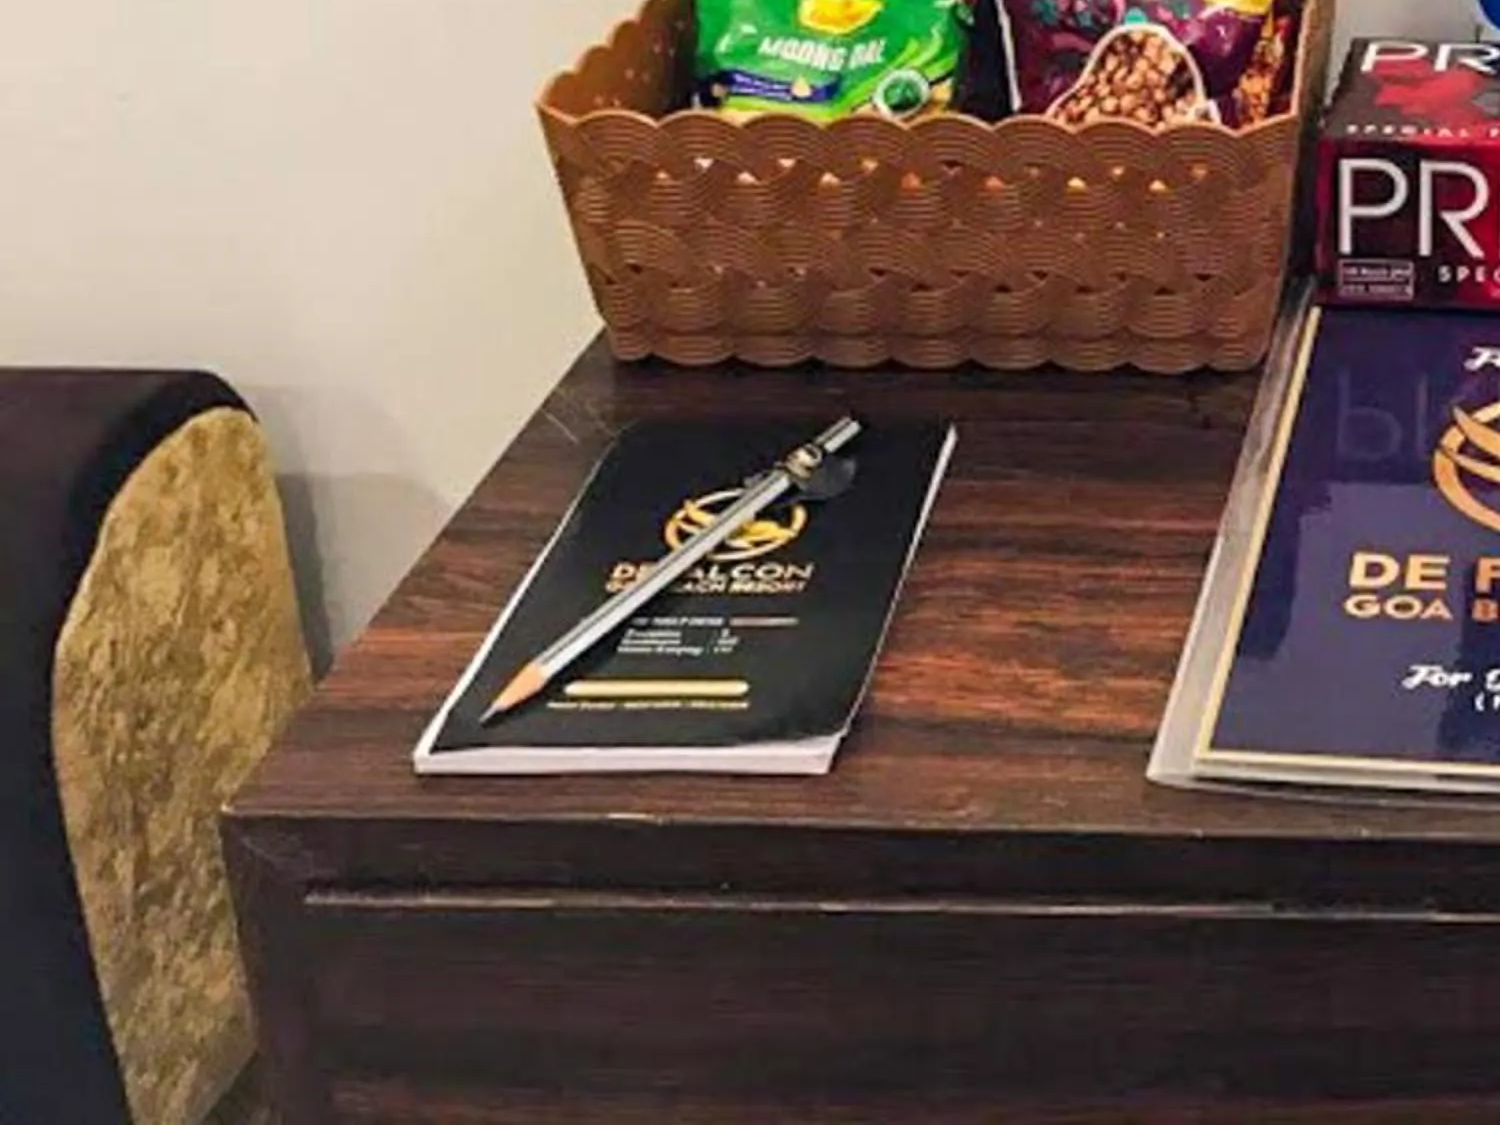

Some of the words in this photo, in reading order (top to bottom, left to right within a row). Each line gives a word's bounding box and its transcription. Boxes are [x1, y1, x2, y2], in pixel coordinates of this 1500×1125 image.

[687, 562, 816, 584] ALCON
[1346, 551, 1450, 592] DE
[1343, 593, 1454, 622] GOA
[1402, 664, 1472, 690] For
